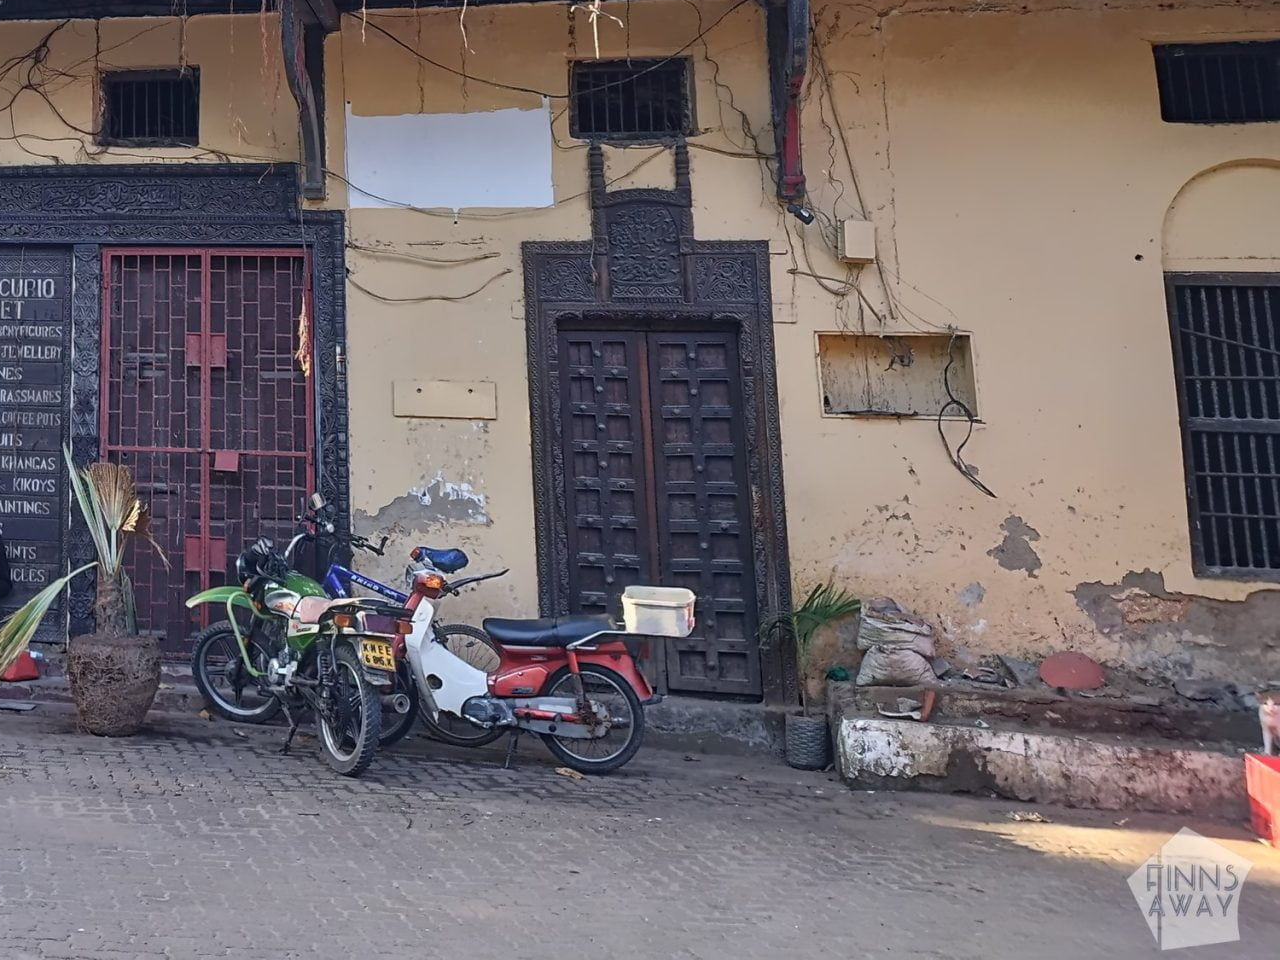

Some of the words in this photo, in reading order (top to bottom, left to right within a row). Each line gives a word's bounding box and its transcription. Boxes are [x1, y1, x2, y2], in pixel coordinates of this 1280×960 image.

[36, 412, 61, 427] POTS
[1, 455, 56, 471] KHANGAS
[12, 478, 56, 493] KIKOYS
